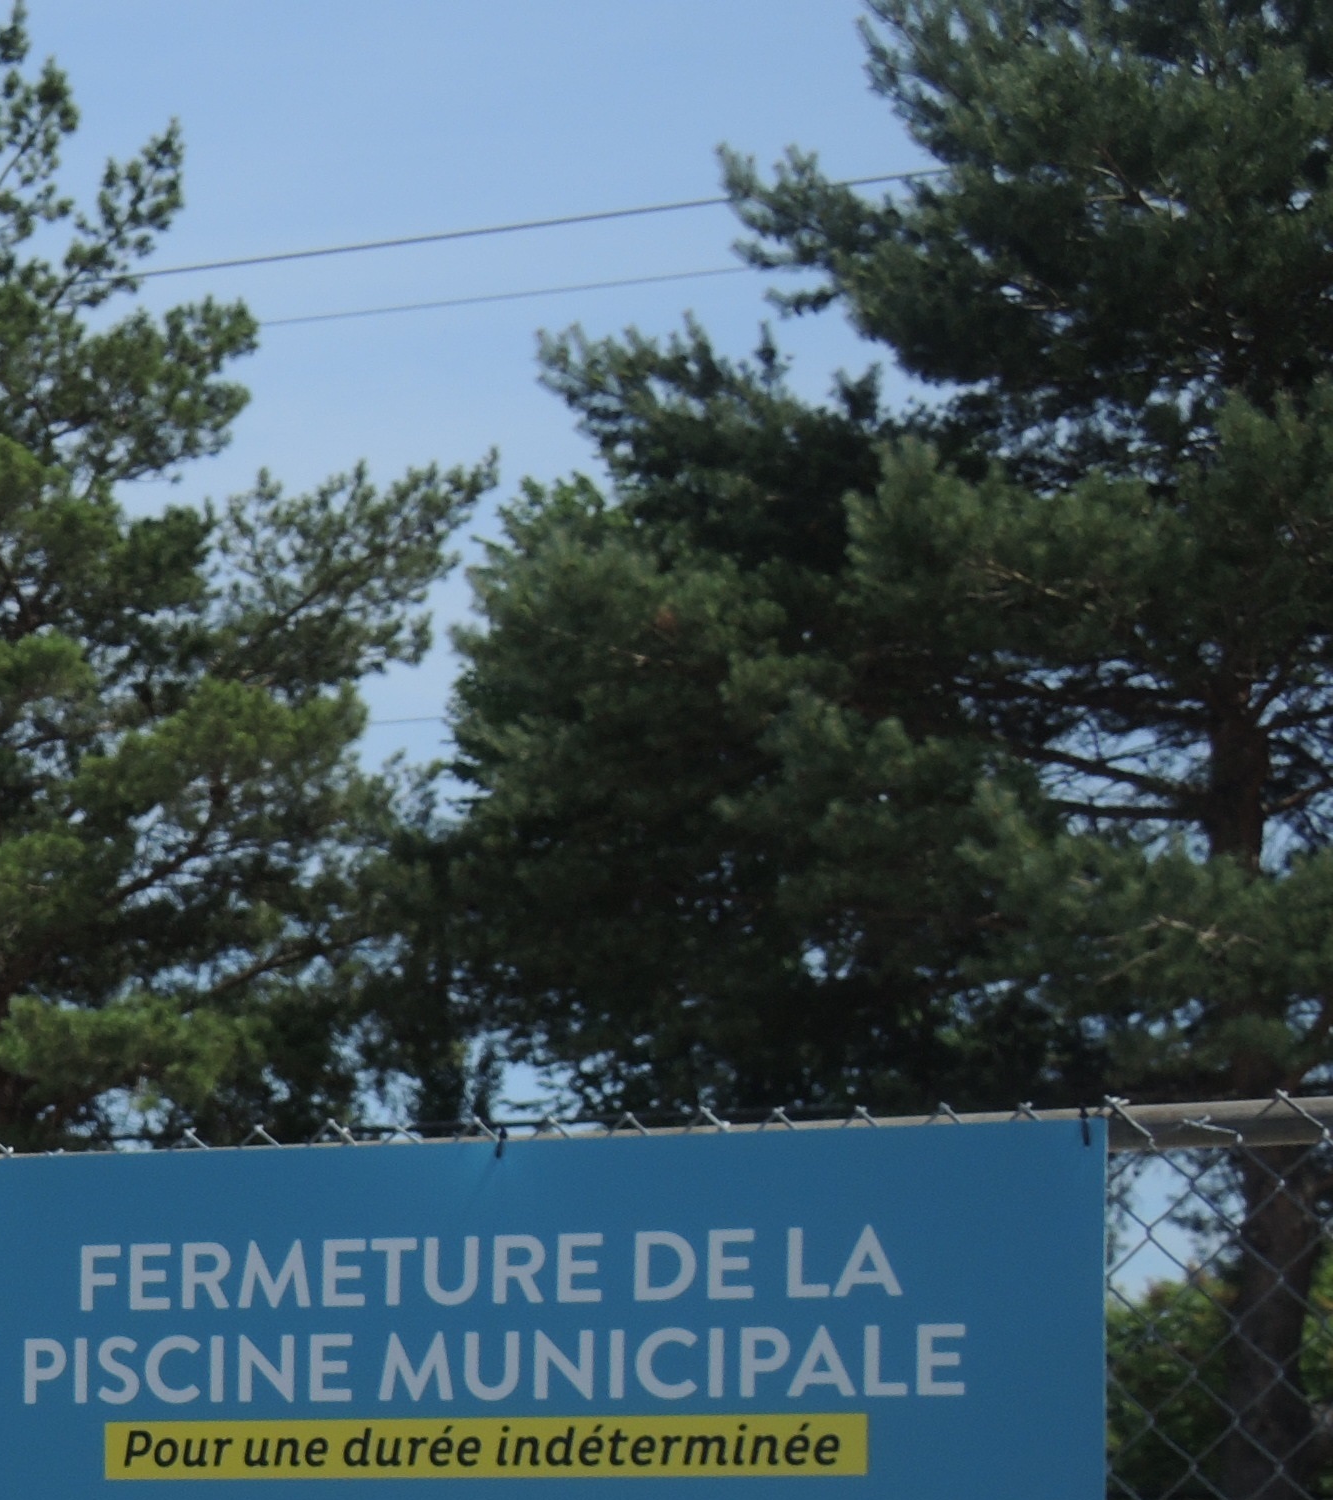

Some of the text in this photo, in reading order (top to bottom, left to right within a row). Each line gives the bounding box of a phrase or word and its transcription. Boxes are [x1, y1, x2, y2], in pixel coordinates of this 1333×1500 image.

[79, 1223, 904, 1312] FERMETURE DE LA
[23, 1322, 967, 1405] PISCINE MUNICIPALE
[123, 1421, 841, 1468] Pour une durée indéterminée
